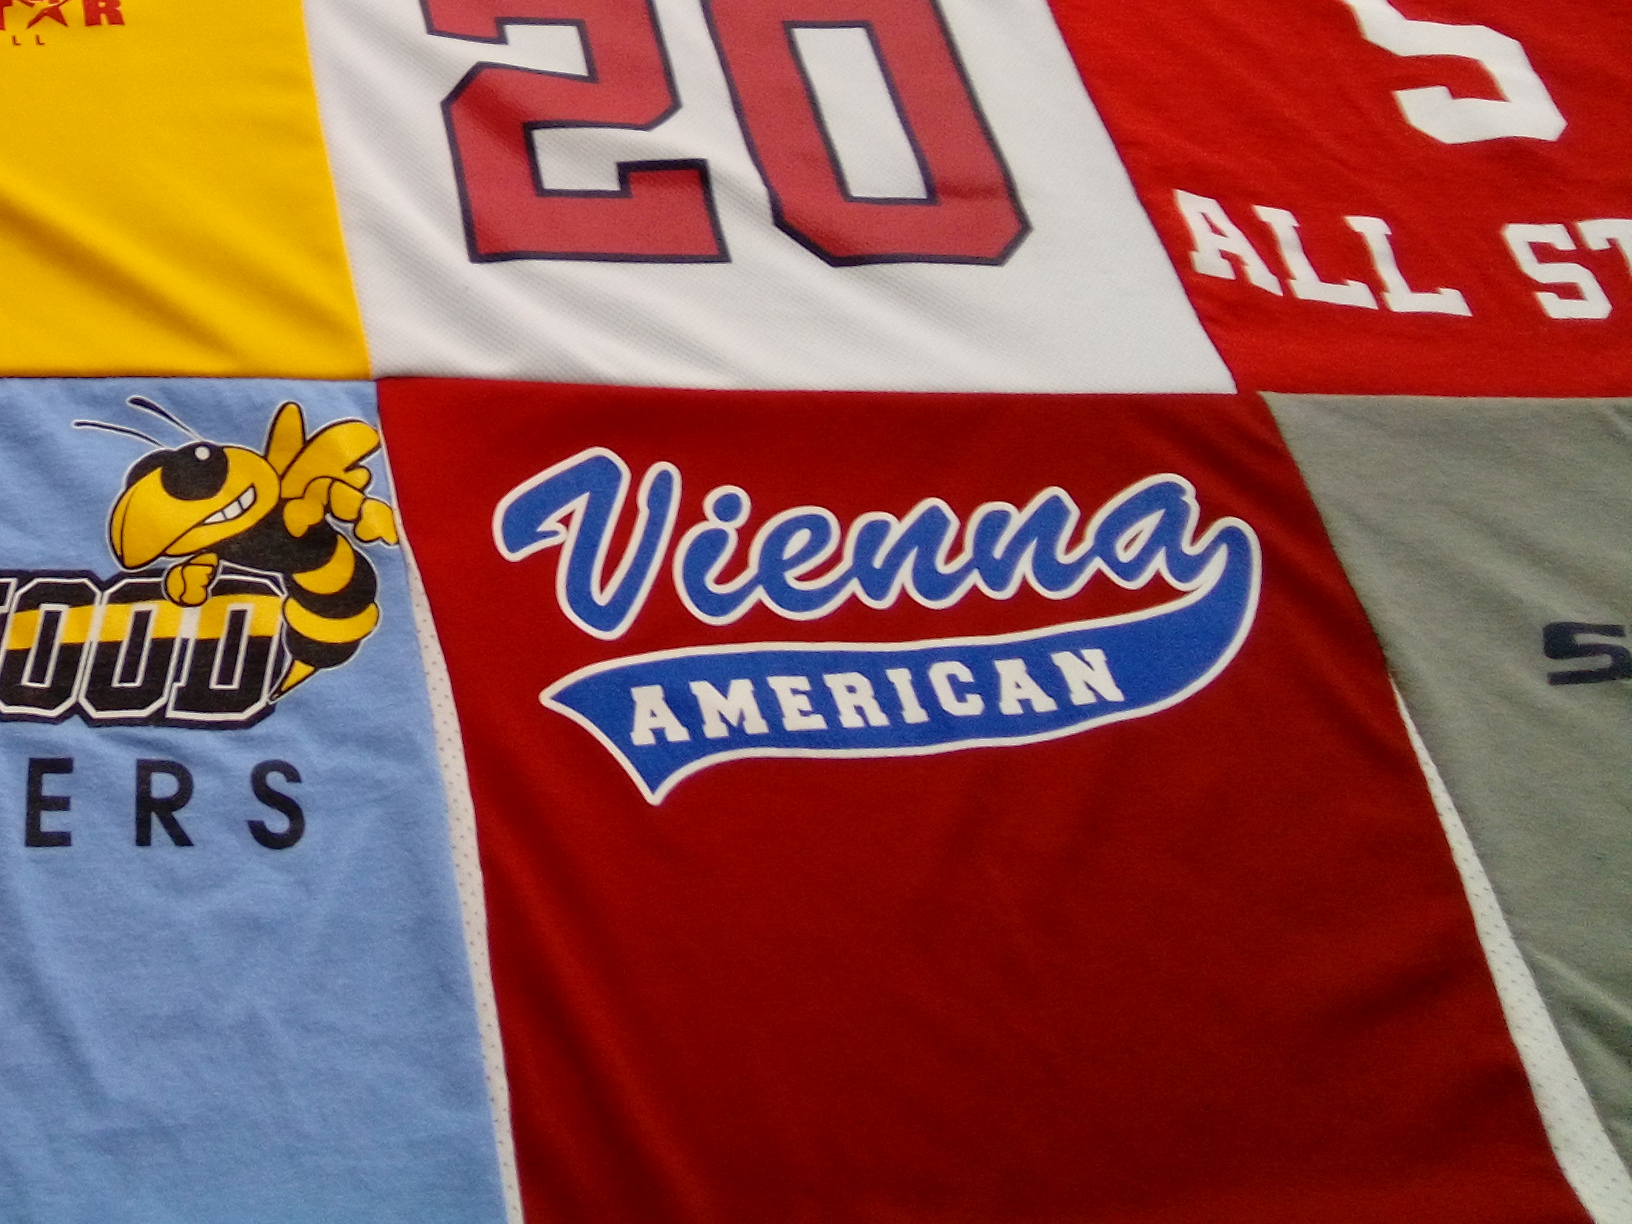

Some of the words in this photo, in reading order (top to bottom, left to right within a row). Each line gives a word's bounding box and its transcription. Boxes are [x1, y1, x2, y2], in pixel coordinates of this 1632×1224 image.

[1173, 189, 1473, 317] ALL
[493, 445, 1261, 640] Vienna
[628, 648, 1125, 746] AMERICAN
